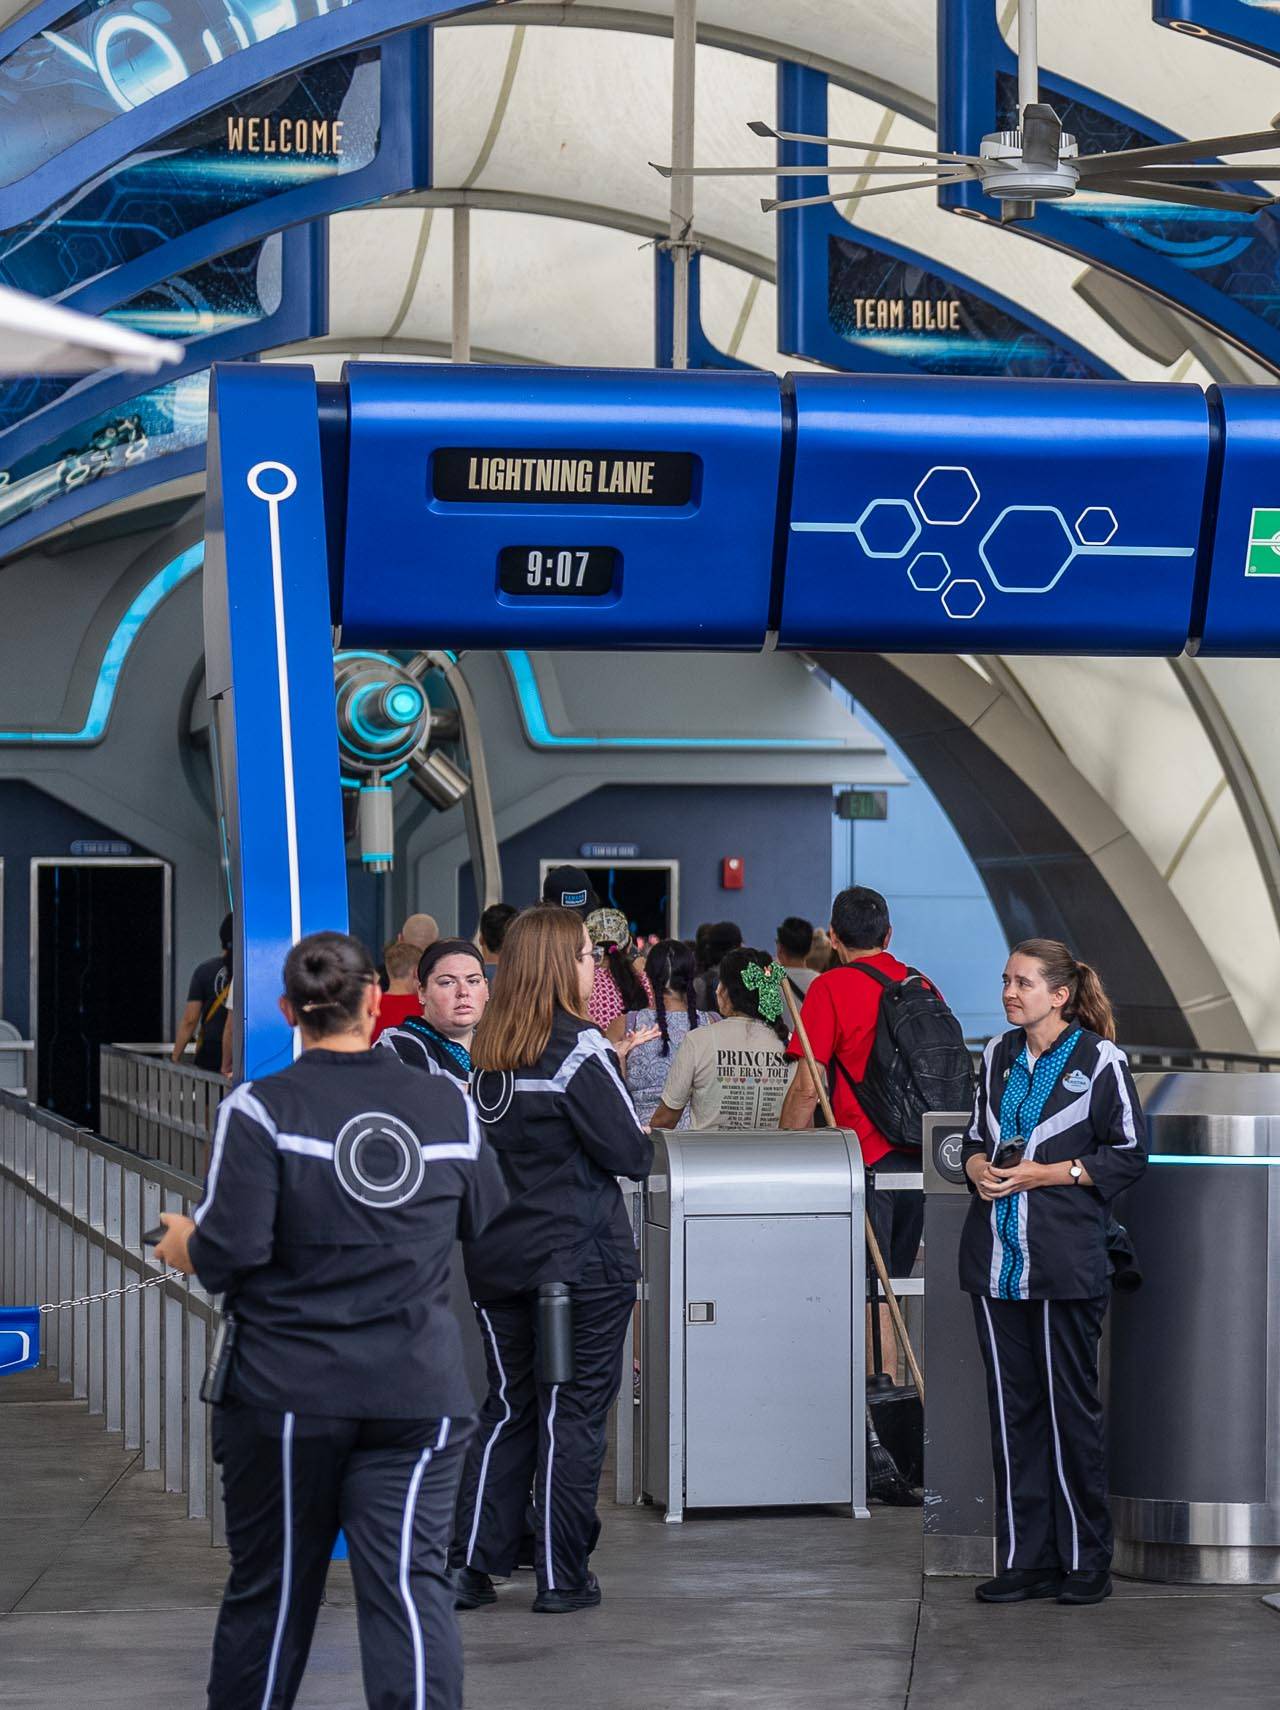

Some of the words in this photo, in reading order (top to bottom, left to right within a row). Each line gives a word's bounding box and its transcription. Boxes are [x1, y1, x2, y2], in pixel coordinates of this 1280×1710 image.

[227, 117, 344, 154] WELCOME
[853, 299, 904, 329] TEAM
[912, 300, 960, 330] BLUE
[468, 458, 593, 492] LIGHTNING
[598, 460, 654, 494] LANE
[527, 551, 589, 587] 9:07
[717, 1066, 736, 1077] THE
[740, 1067, 763, 1078] ERAS
[768, 1068, 789, 1079] TOUR
